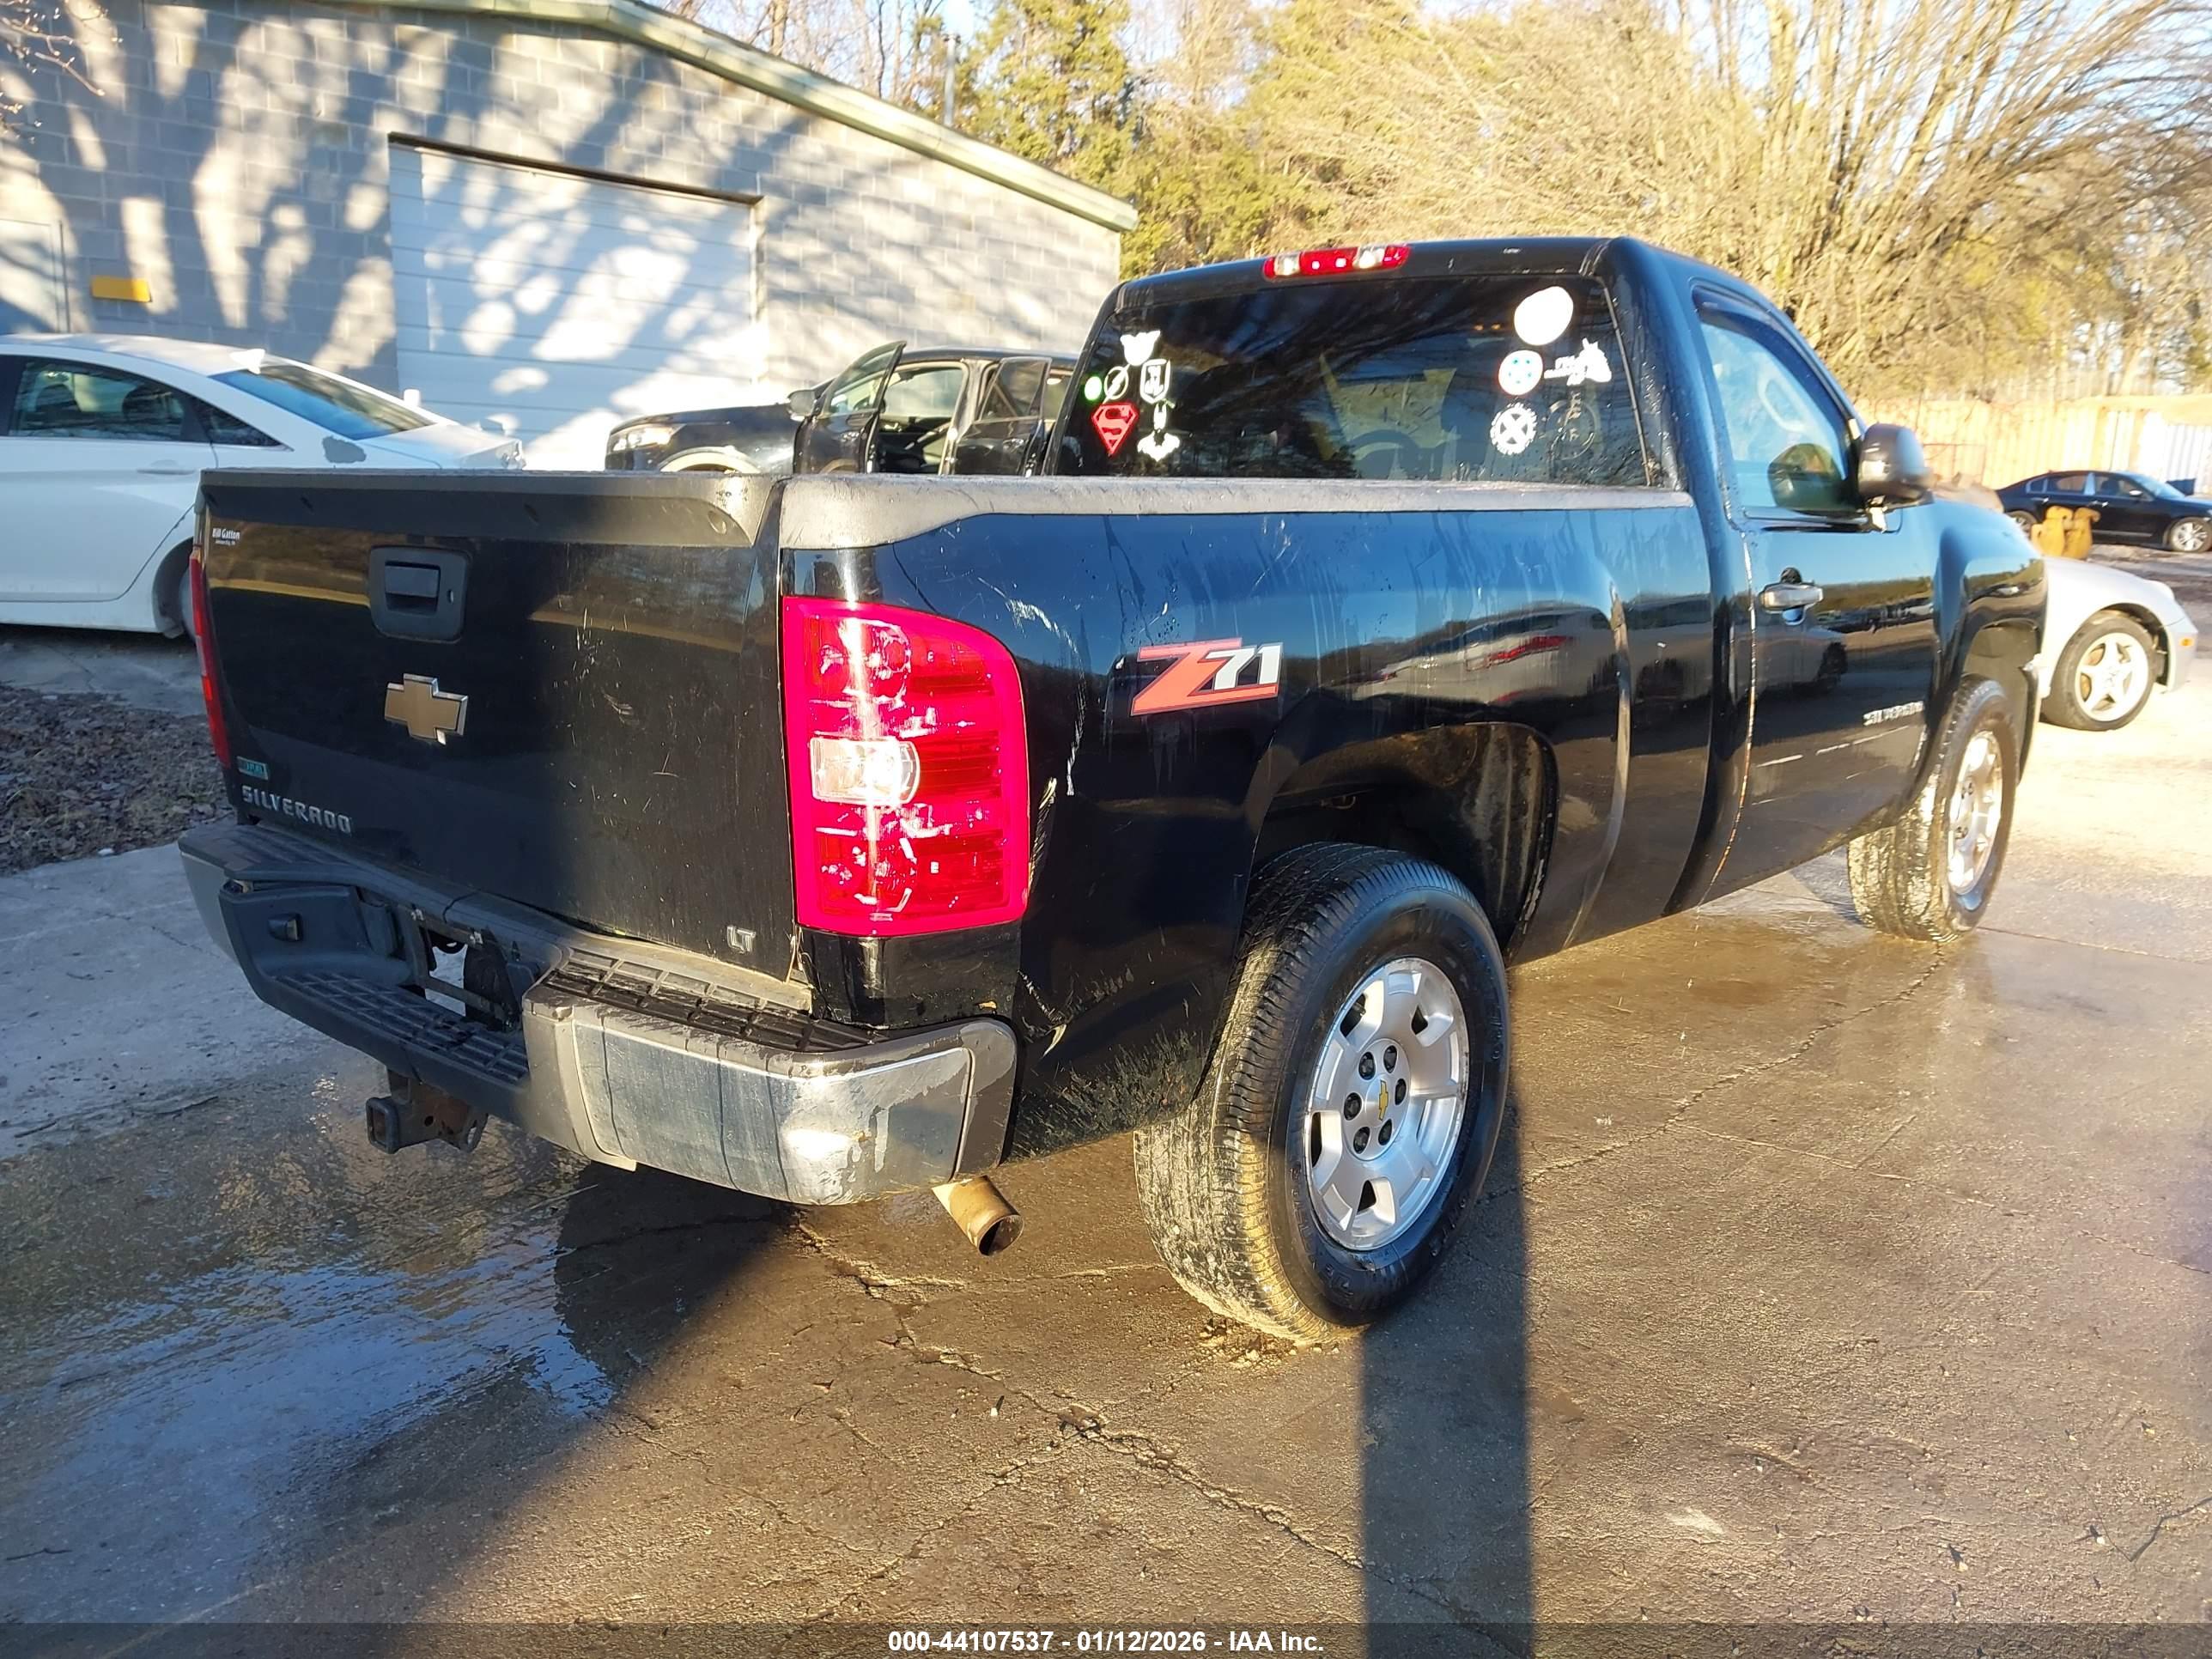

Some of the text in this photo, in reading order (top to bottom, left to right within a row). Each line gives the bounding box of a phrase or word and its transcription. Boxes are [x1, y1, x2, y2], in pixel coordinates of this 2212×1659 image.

[1131, 638, 1283, 716] Z71
[241, 784, 352, 834] SILVERADO
[726, 926, 757, 954] LT
